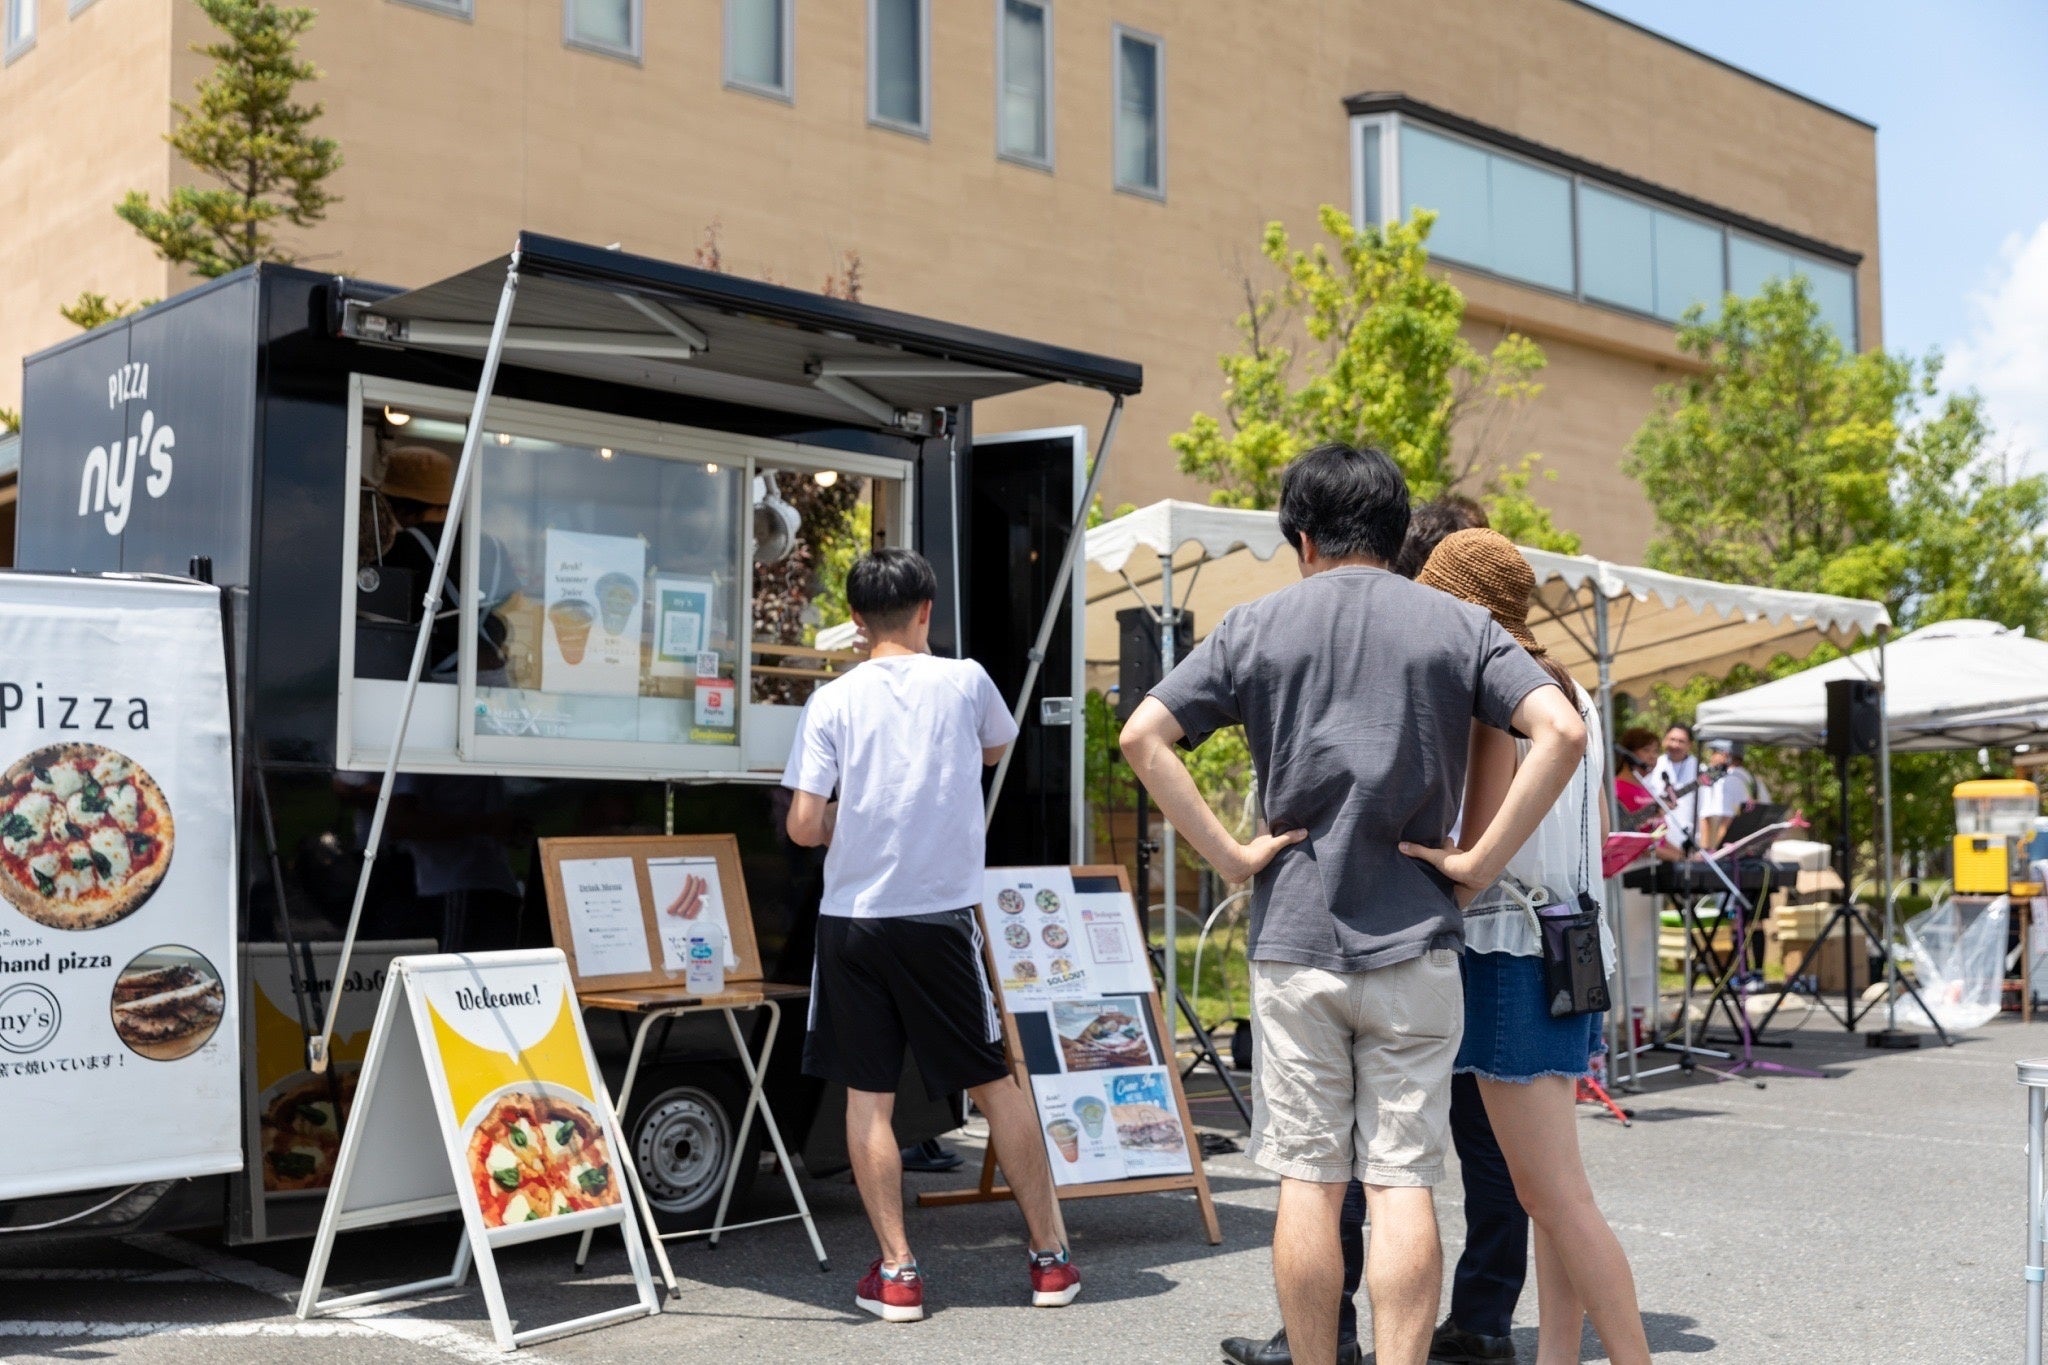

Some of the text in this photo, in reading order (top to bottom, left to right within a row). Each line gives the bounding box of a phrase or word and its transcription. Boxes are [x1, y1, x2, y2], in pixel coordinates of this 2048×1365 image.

[108, 362, 149, 410] PIZZA
[78, 409, 175, 536] ny's
[0, 682, 150, 730] Pizza
[58, 951, 112, 974] pizza
[455, 984, 541, 1011] Welcome!
[1, 1007, 50, 1034] ny's
